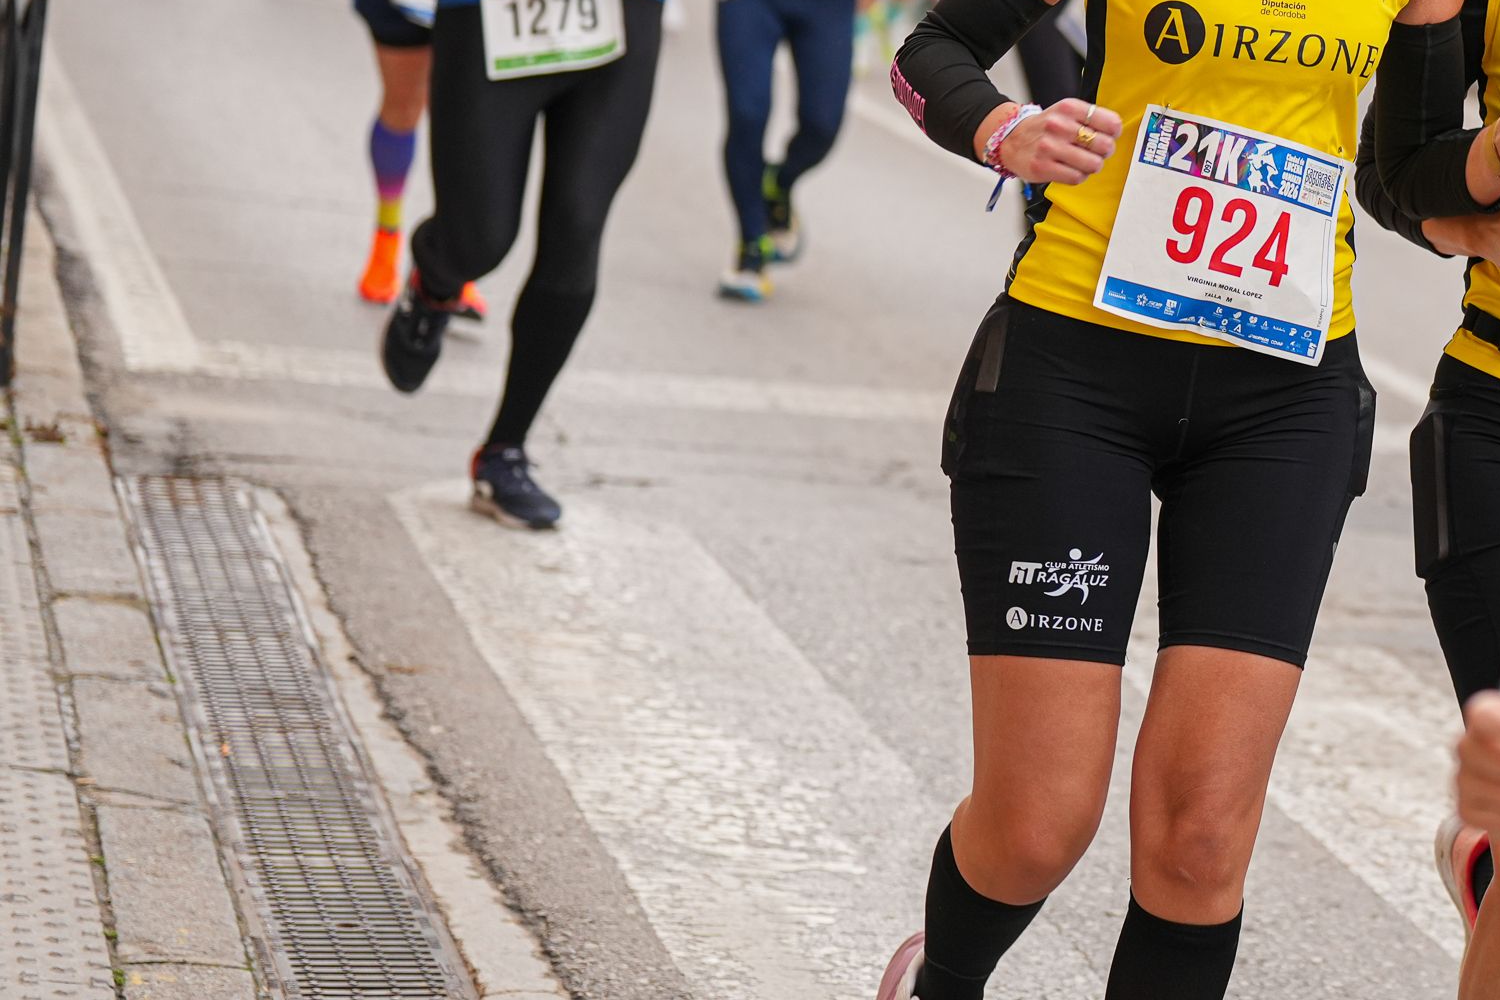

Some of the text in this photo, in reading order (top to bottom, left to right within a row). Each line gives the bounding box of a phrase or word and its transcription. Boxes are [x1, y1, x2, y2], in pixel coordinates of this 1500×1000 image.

[1150, 4, 1379, 79] AIRZONE
[1168, 122, 1248, 185] 21K
[1278, 180, 1299, 199] 2026
[1165, 186, 1290, 287] 924
[1187, 275, 1263, 300] VIRGINIA MORAL LOPEZ
[1204, 292, 1222, 300] TALLA
[1068, 563, 1110, 572] ATLETISMO
[1008, 608, 1104, 632] AIRZONE
